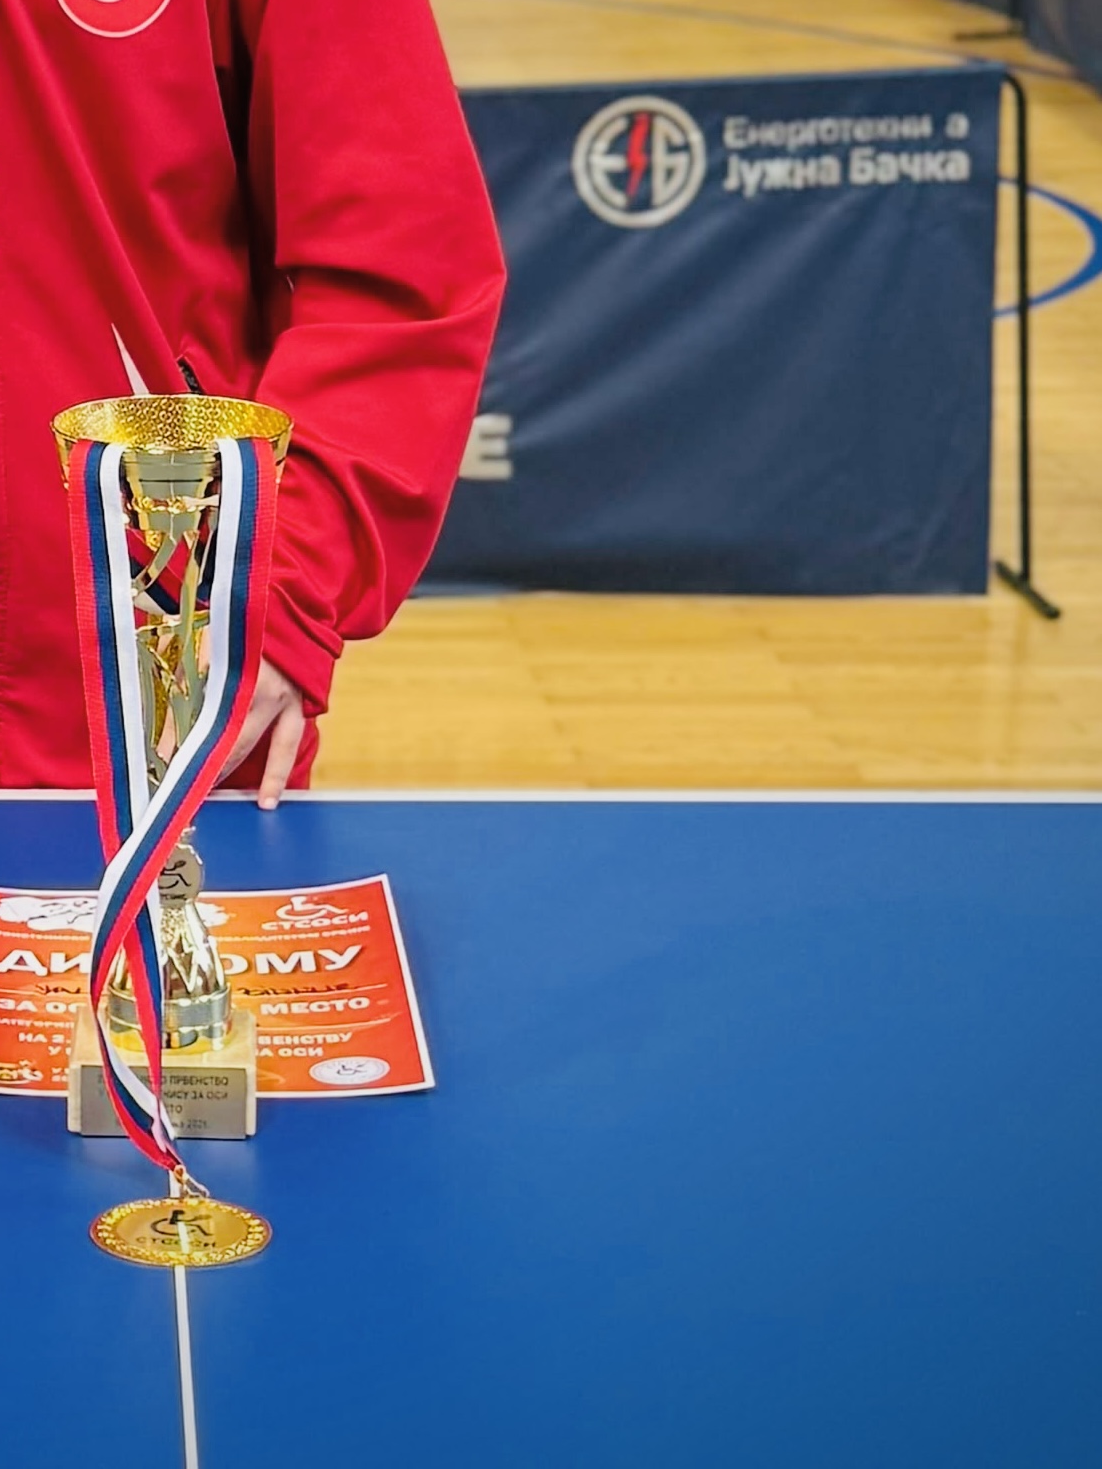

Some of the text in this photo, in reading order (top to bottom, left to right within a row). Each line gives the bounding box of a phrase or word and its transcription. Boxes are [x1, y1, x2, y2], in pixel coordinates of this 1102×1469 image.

[723, 114, 970, 152] Енерготехниа
[723, 146, 971, 199] Јужна Бачка
[261, 911, 369, 930] СТСОСИ
[260, 997, 371, 1015] МЕСТО
[18, 1032, 47, 1043] НА
[258, 1032, 353, 1045] ВЕНСТВУ
[278, 1047, 323, 1057] ОСИ
[169, 1075, 229, 1086] ПРВЕНСТВО
[163, 1090, 188, 1100] НИСУ
